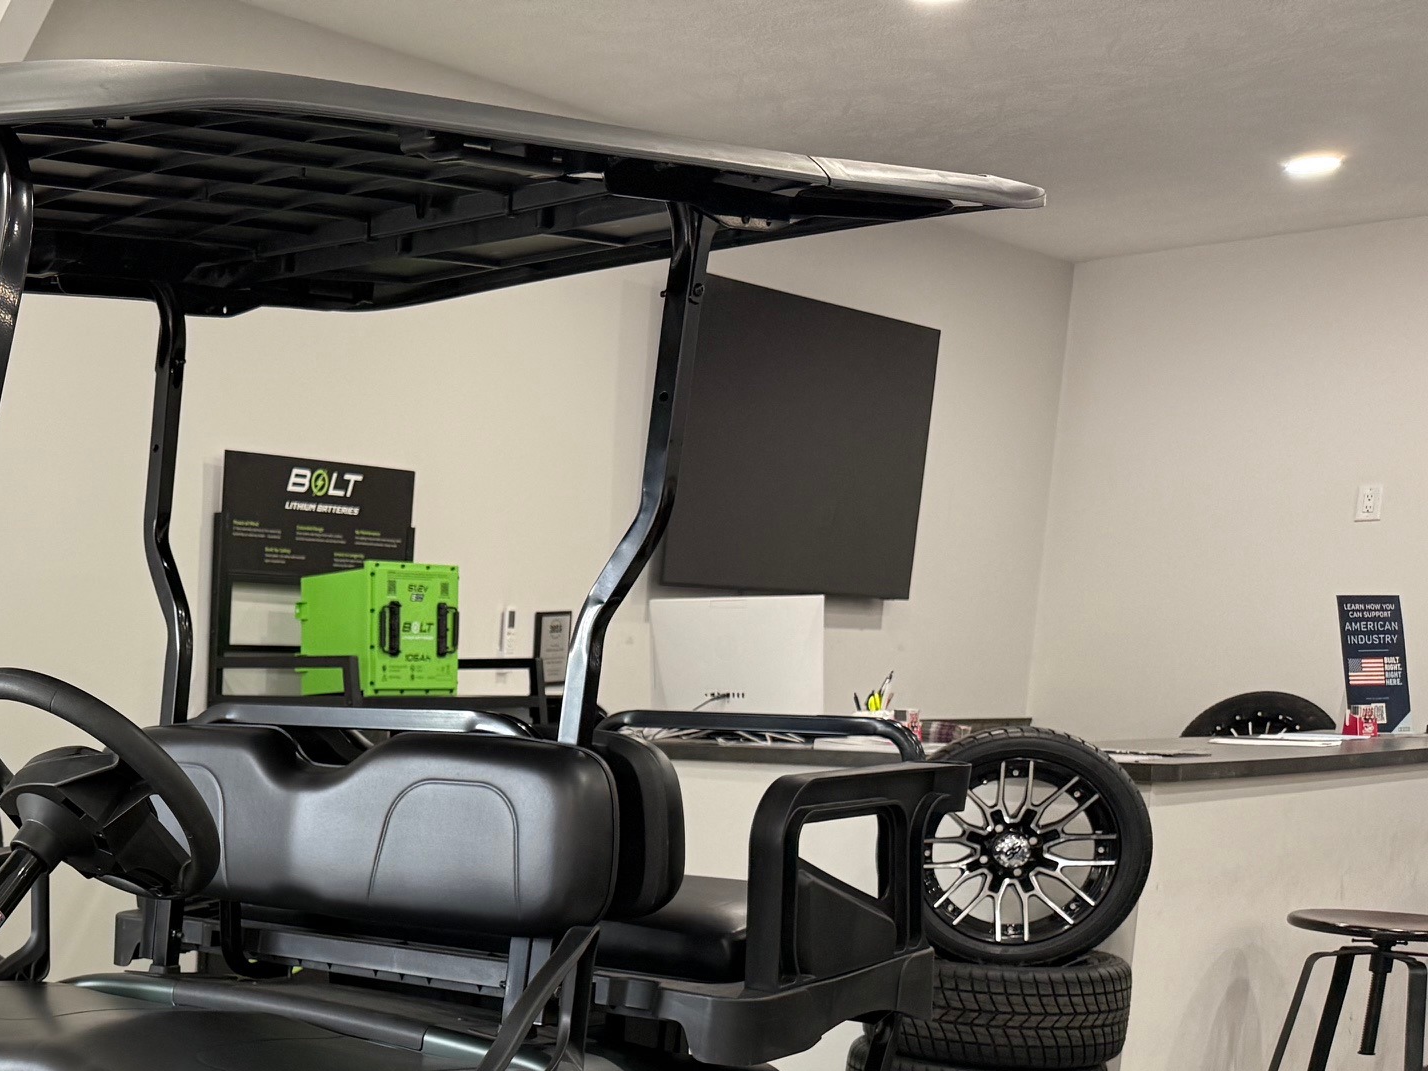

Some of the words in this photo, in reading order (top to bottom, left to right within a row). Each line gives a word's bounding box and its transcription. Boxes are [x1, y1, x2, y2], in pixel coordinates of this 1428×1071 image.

[286, 467, 364, 498] BOLT
[284, 501, 317, 512] LITHIUM
[316, 503, 360, 516] BATTERIES
[1343, 603, 1364, 611] LEARN
[1344, 621, 1399, 631] AMERICAN
[1347, 634, 1398, 645] INDUSTRY
